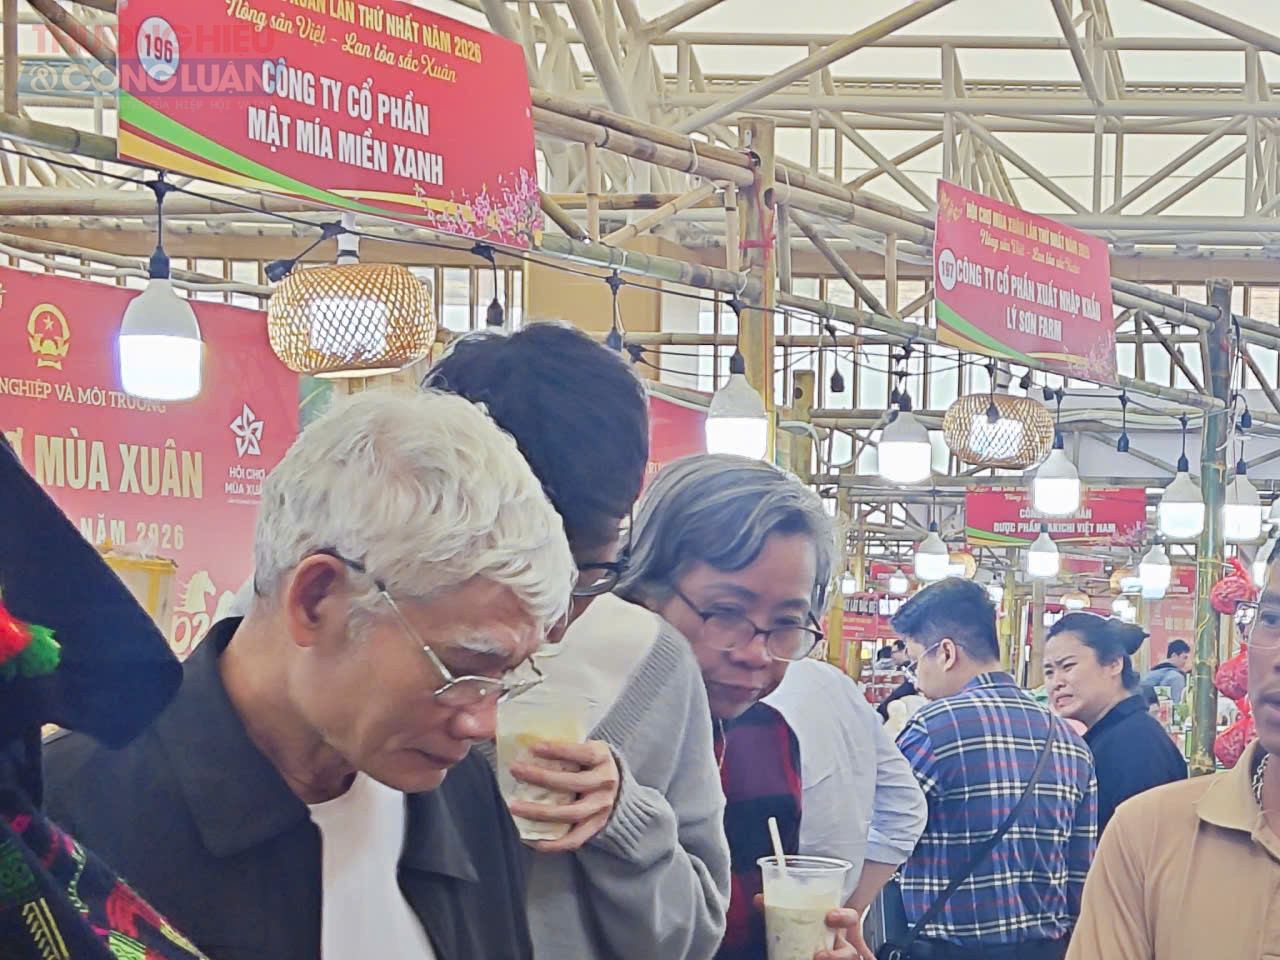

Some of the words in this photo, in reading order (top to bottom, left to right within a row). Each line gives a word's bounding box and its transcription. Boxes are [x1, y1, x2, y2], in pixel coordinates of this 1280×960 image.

[145, 33, 174, 64] 196
[341, 32, 371, 57] Lan
[386, 12, 419, 44] NHẤT
[422, 24, 452, 54] NĂM
[454, 35, 482, 64] 2026
[262, 56, 316, 106] CÔNG
[320, 76, 343, 113] TY
[347, 77, 374, 122] CỔ
[377, 90, 430, 136] PHẦN
[247, 105, 291, 153] MẬT
[295, 117, 334, 160] MÍA
[392, 143, 444, 186] XANH
[956, 256, 982, 288] CÔNG
[983, 267, 995, 291] TY
[1036, 279, 1058, 309] XUẤT
[1006, 304, 1017, 330] LÝ
[1018, 309, 1037, 337] SƠN
[1038, 315, 1063, 342] FARM
[55, 381, 75, 402] VÀ
[77, 386, 106, 407] MÔI
[33, 427, 110, 492] MÙA
[119, 438, 204, 499] XUÂN
[80, 513, 126, 546] NĂM
[137, 521, 184, 550] 2026
[1077, 520, 1095, 536] VIỆT
[1096, 523, 1116, 533] NAM
